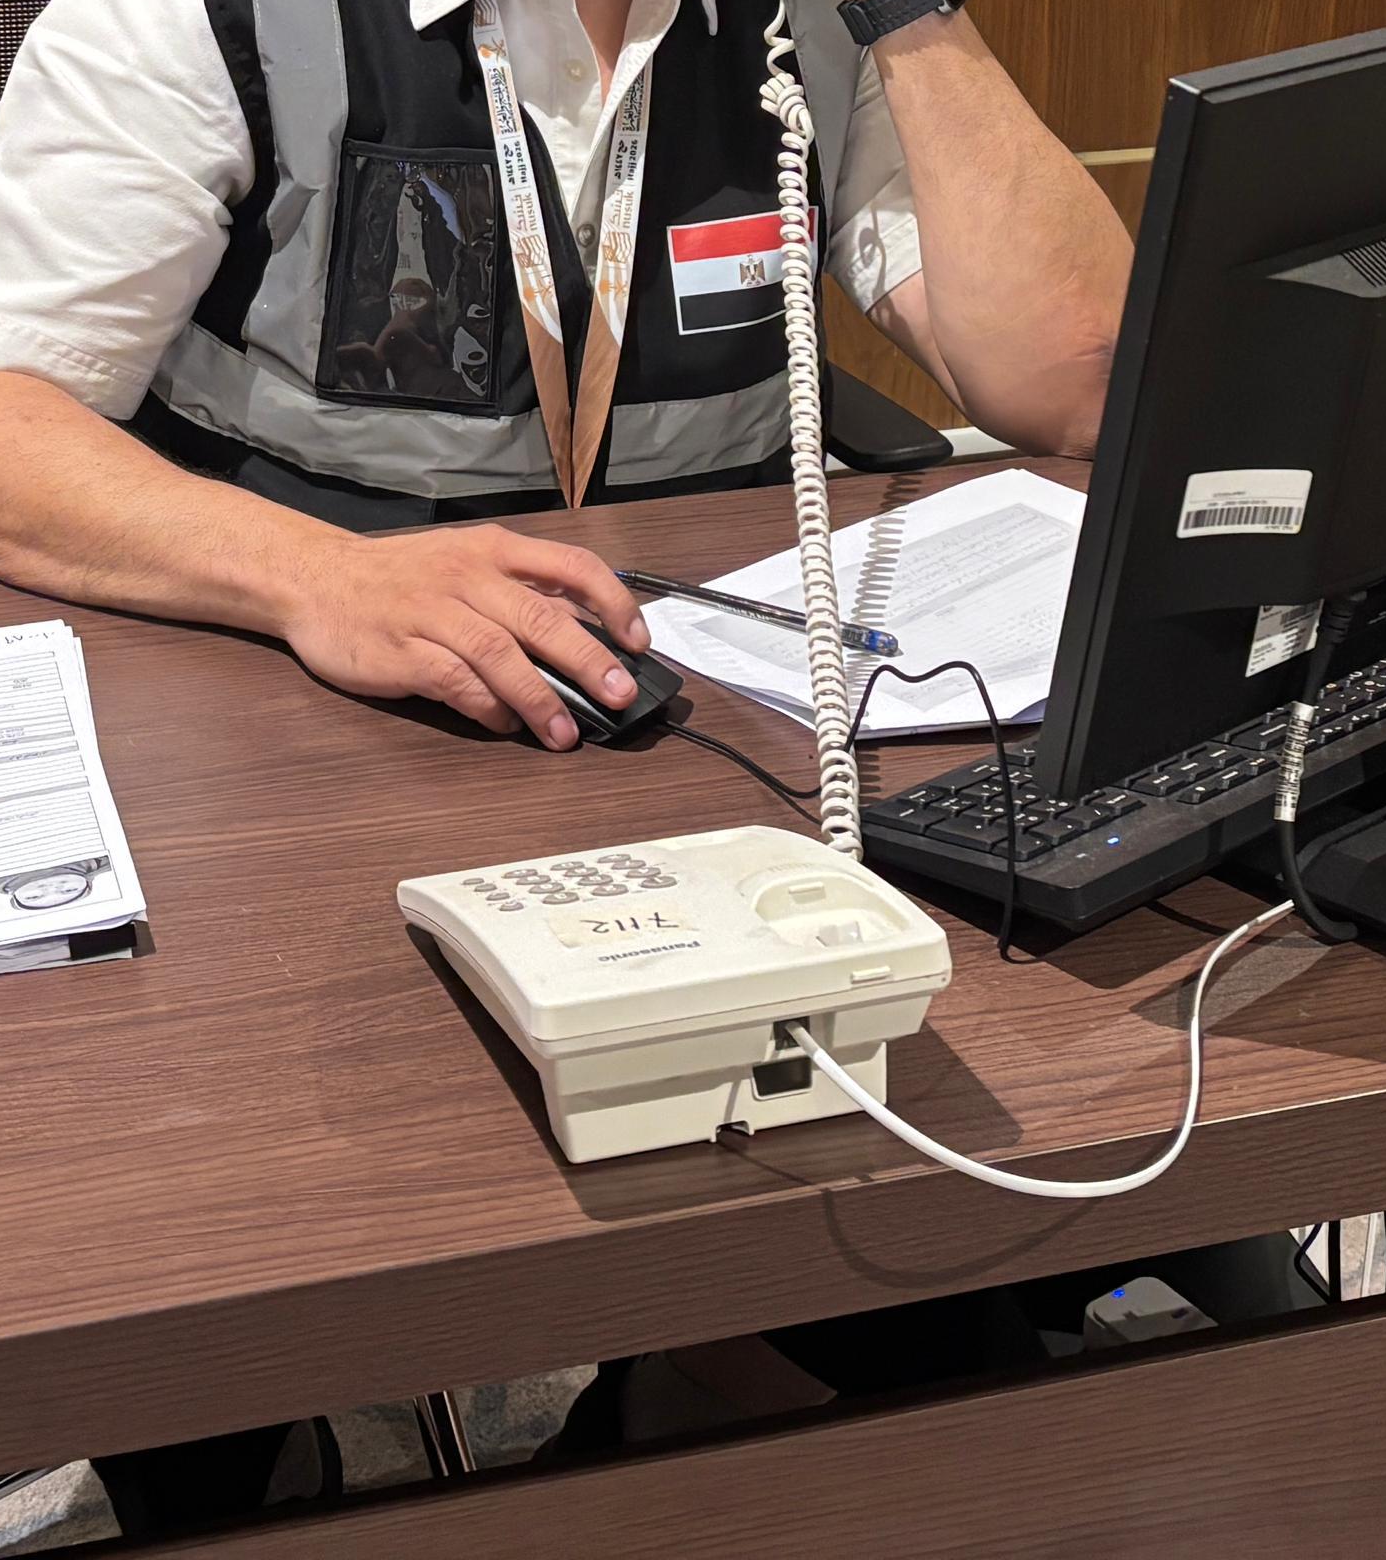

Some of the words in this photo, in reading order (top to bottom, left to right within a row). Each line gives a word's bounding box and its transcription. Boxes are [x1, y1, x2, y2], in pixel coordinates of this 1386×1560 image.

[514, 140, 524, 163] 2026
[629, 139, 638, 161] 2026
[517, 164, 528, 183] Hajj
[627, 162, 637, 181] Hajj
[521, 192, 538, 231] nusuk
[622, 191, 634, 229] nusuk
[597, 940, 702, 963] Panasonic
